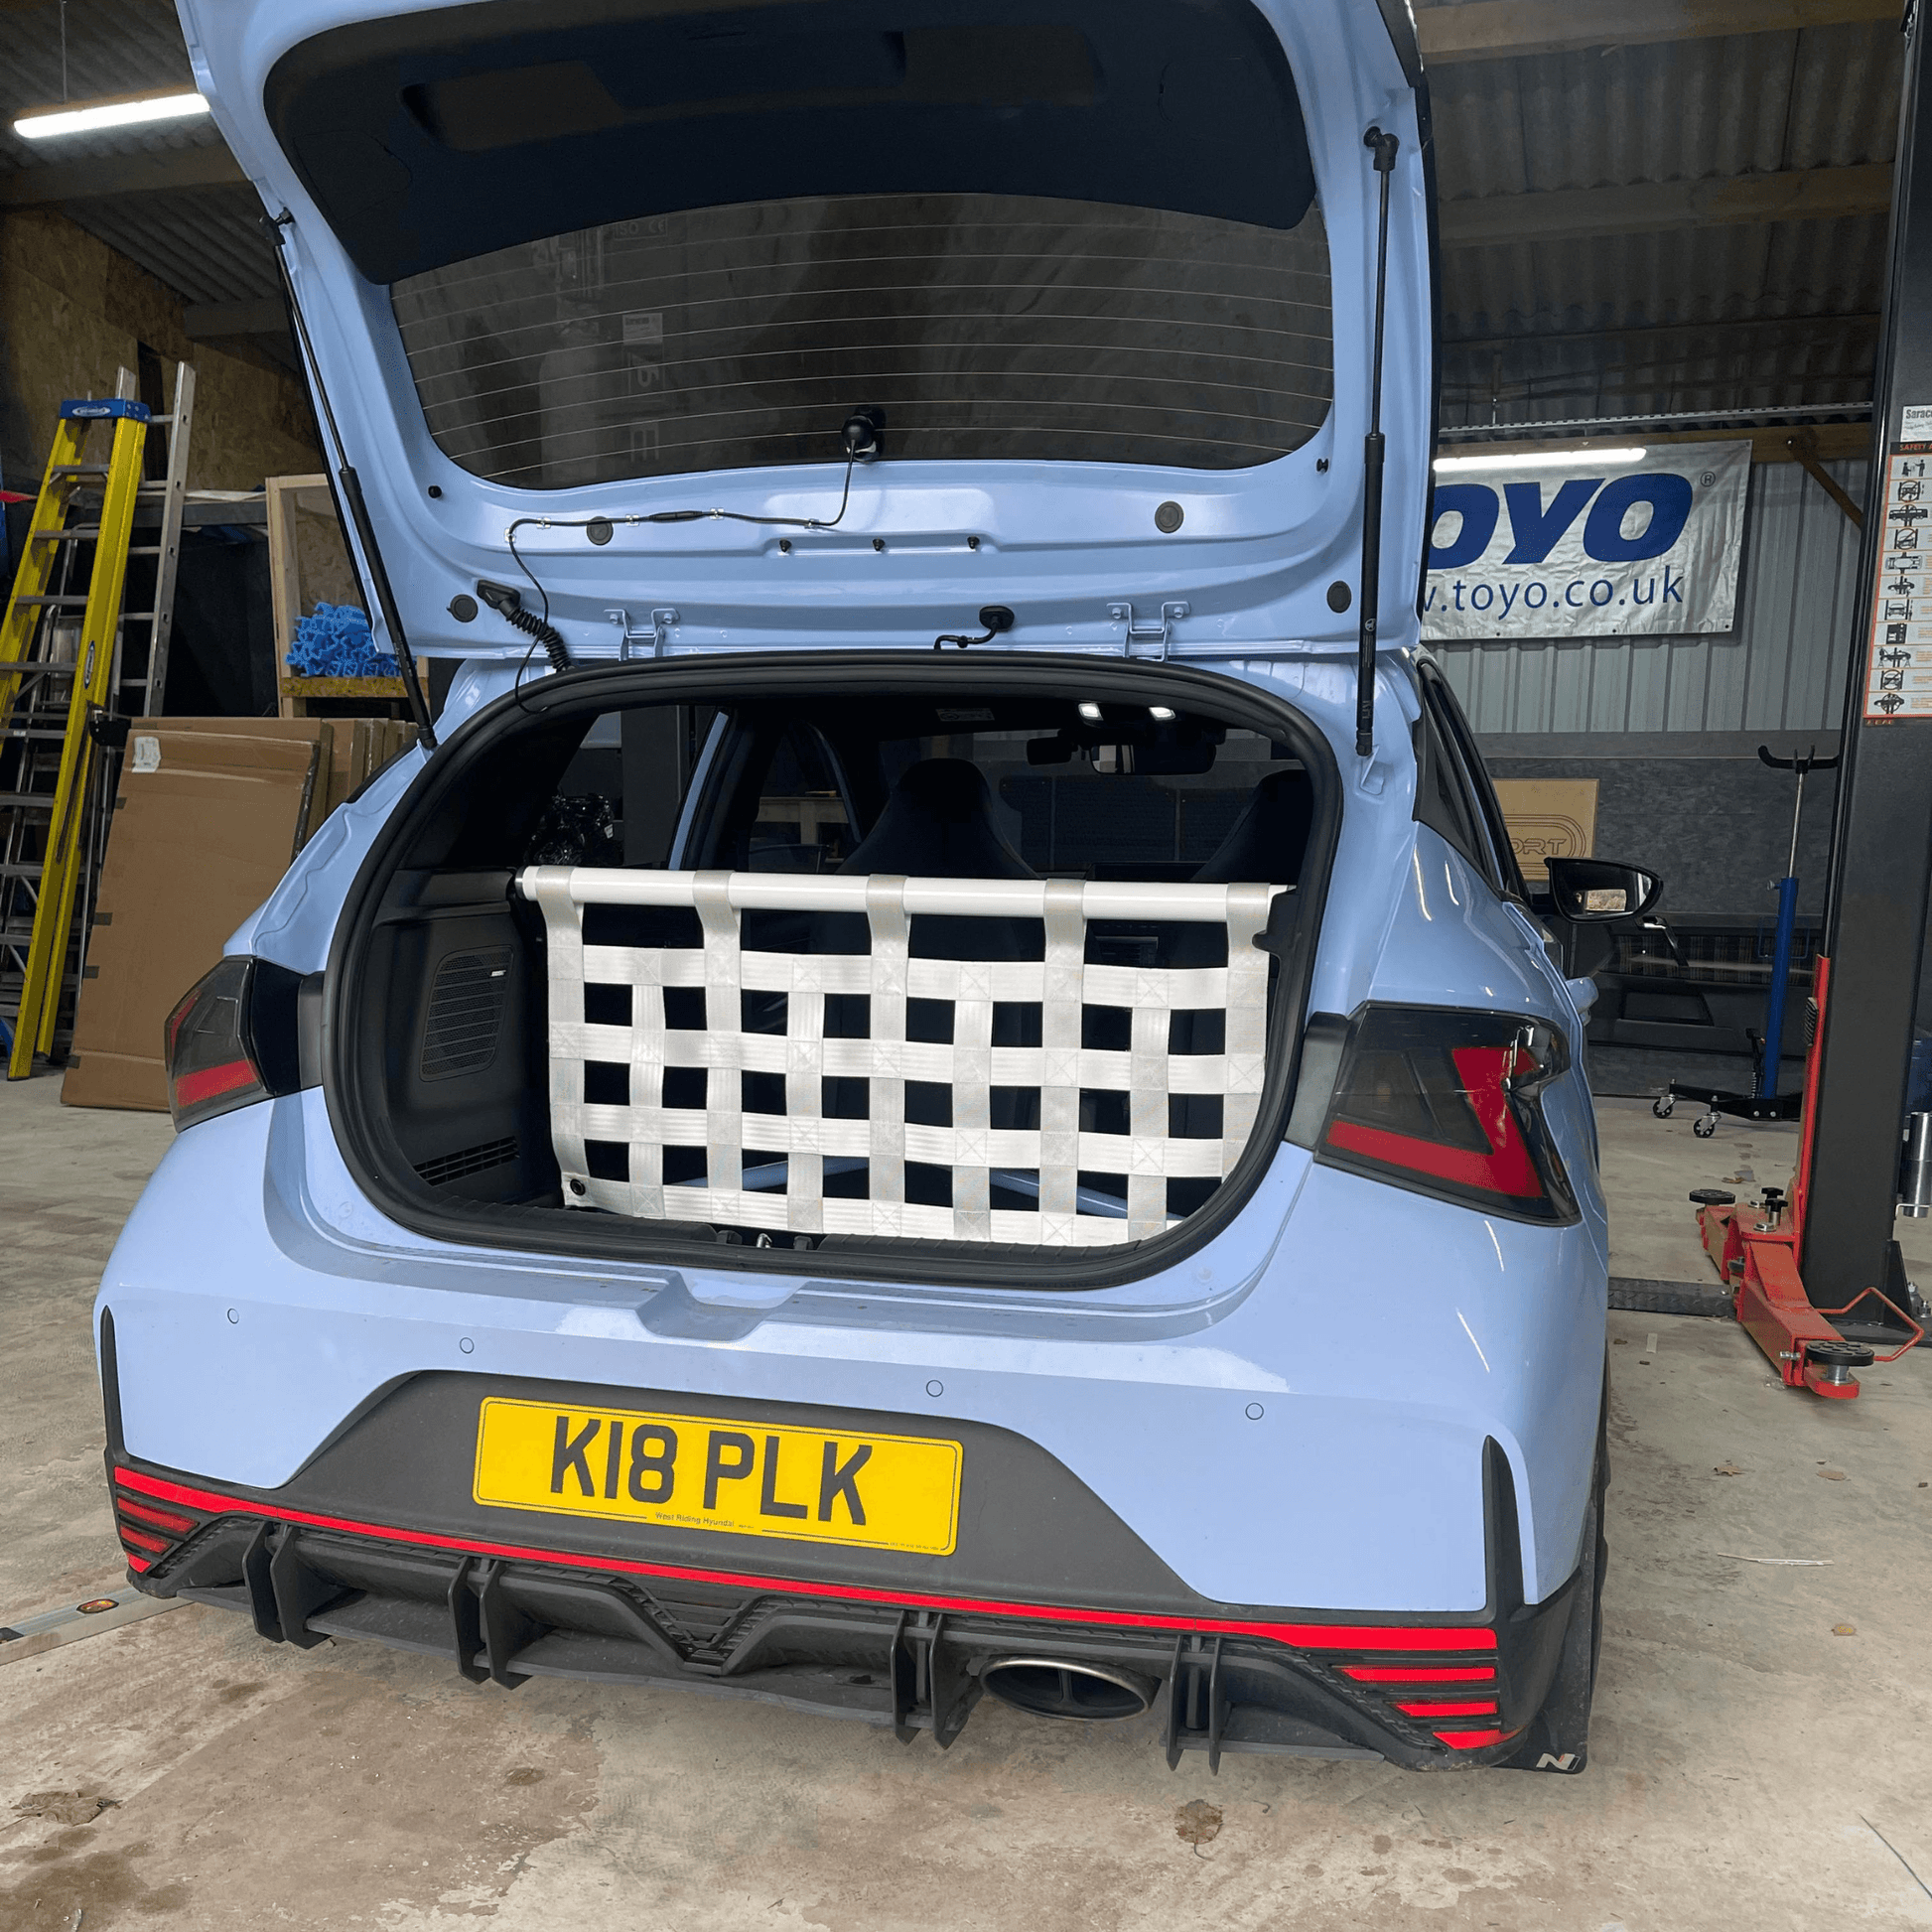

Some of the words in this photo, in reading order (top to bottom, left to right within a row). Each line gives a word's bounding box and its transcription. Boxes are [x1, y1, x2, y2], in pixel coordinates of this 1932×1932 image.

[1905, 409, 1932, 419] Sarac
[550, 1415, 679, 1505] K18
[702, 1430, 874, 1527] PLK
[655, 1511, 675, 1521] West
[675, 1513, 701, 1525] Riding
[703, 1517, 735, 1528] Hyundai
